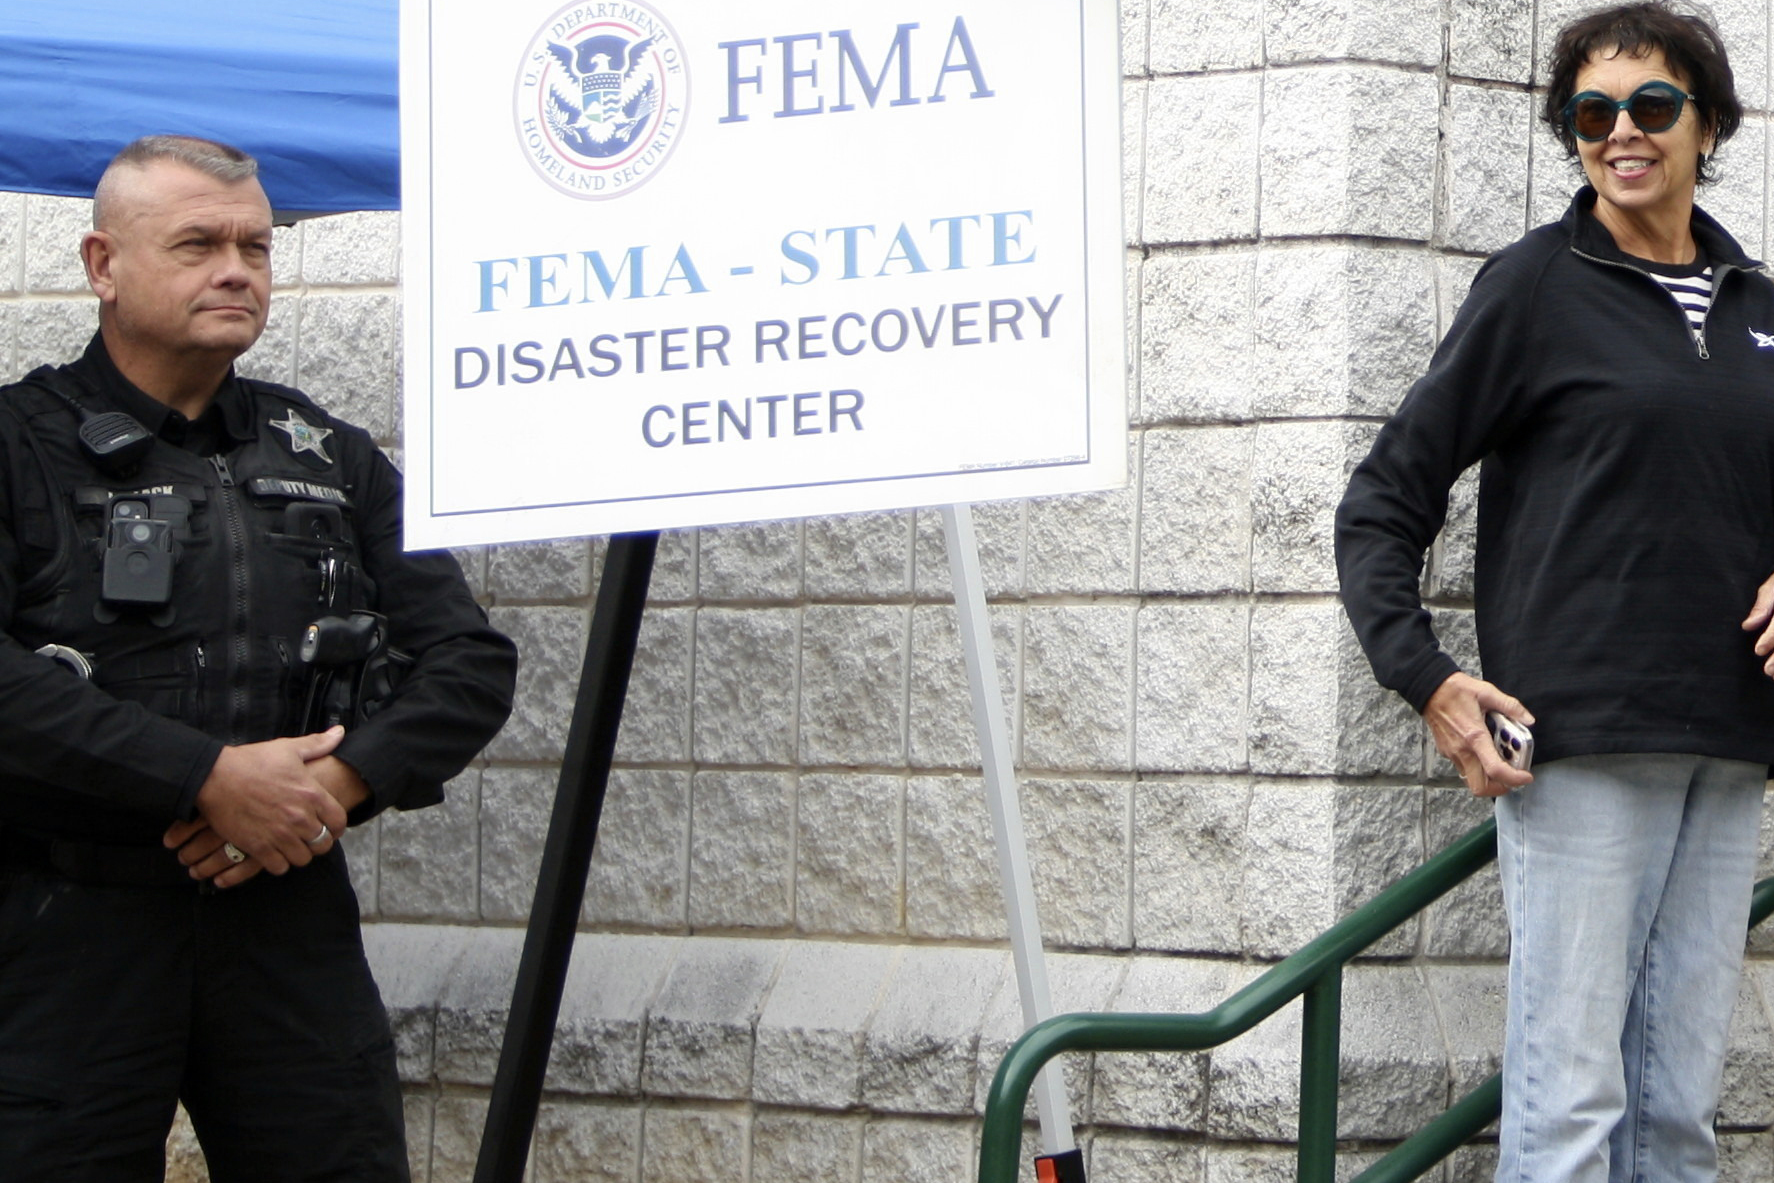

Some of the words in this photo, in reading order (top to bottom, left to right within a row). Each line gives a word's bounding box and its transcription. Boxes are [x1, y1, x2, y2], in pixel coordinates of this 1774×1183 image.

[552, 2, 668, 45] DEPARTMENT
[663, 47, 681, 75] OF
[718, 16, 994, 123] FEMA
[523, 118, 605, 190] HOMELAND
[613, 103, 681, 186] SECURITY
[473, 243, 709, 313] FEMA
[780, 210, 1036, 286] STATE
[454, 324, 731, 389] DISASTER
[755, 294, 1063, 363] RECOVERY
[641, 389, 864, 449] CENTER
